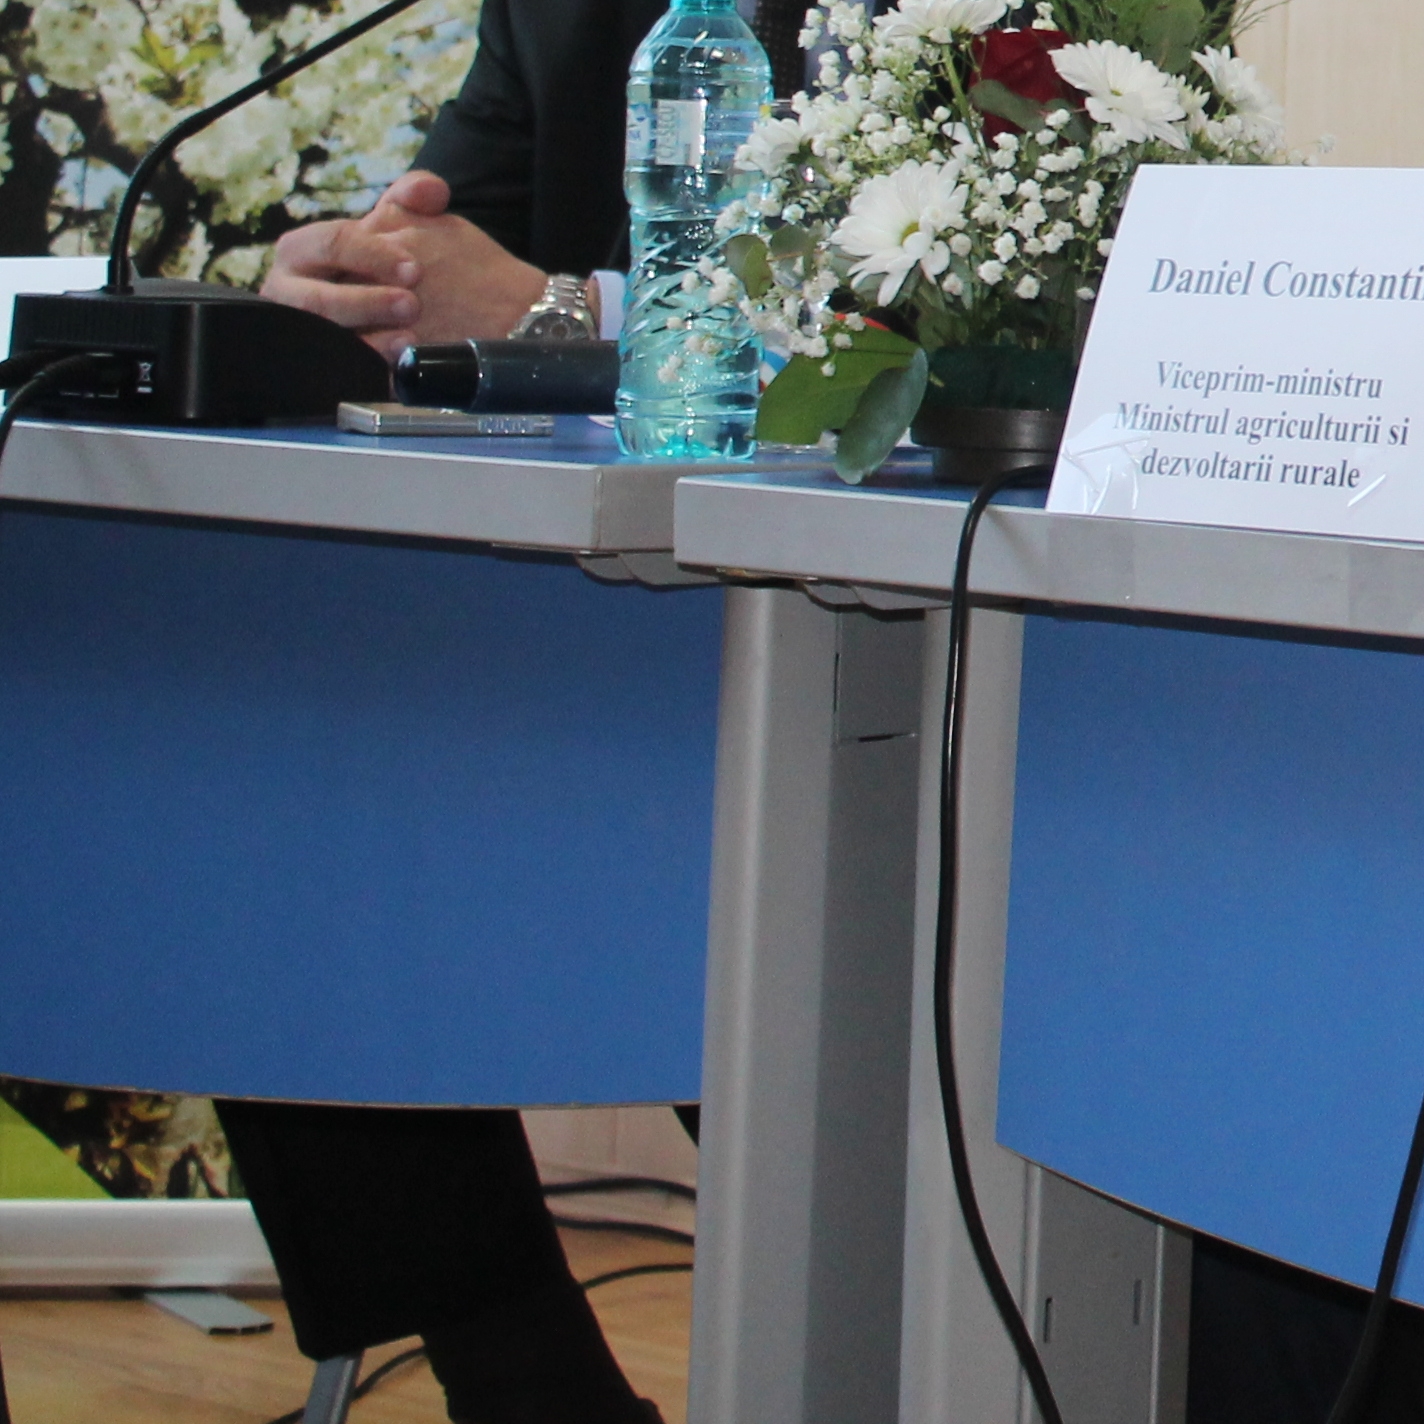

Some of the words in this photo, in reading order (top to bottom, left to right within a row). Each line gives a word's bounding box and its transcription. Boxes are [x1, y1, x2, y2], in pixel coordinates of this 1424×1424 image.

[1147, 257, 1257, 298] Daniel
[1156, 360, 1383, 401] Viceprim-ministru
[1113, 401, 1230, 436] Ministrul
[1235, 410, 1382, 445] agriculturii
[1387, 417, 1410, 447] si
[1140, 447, 1273, 484] dezvoltarii
[1278, 457, 1362, 489] rurale
